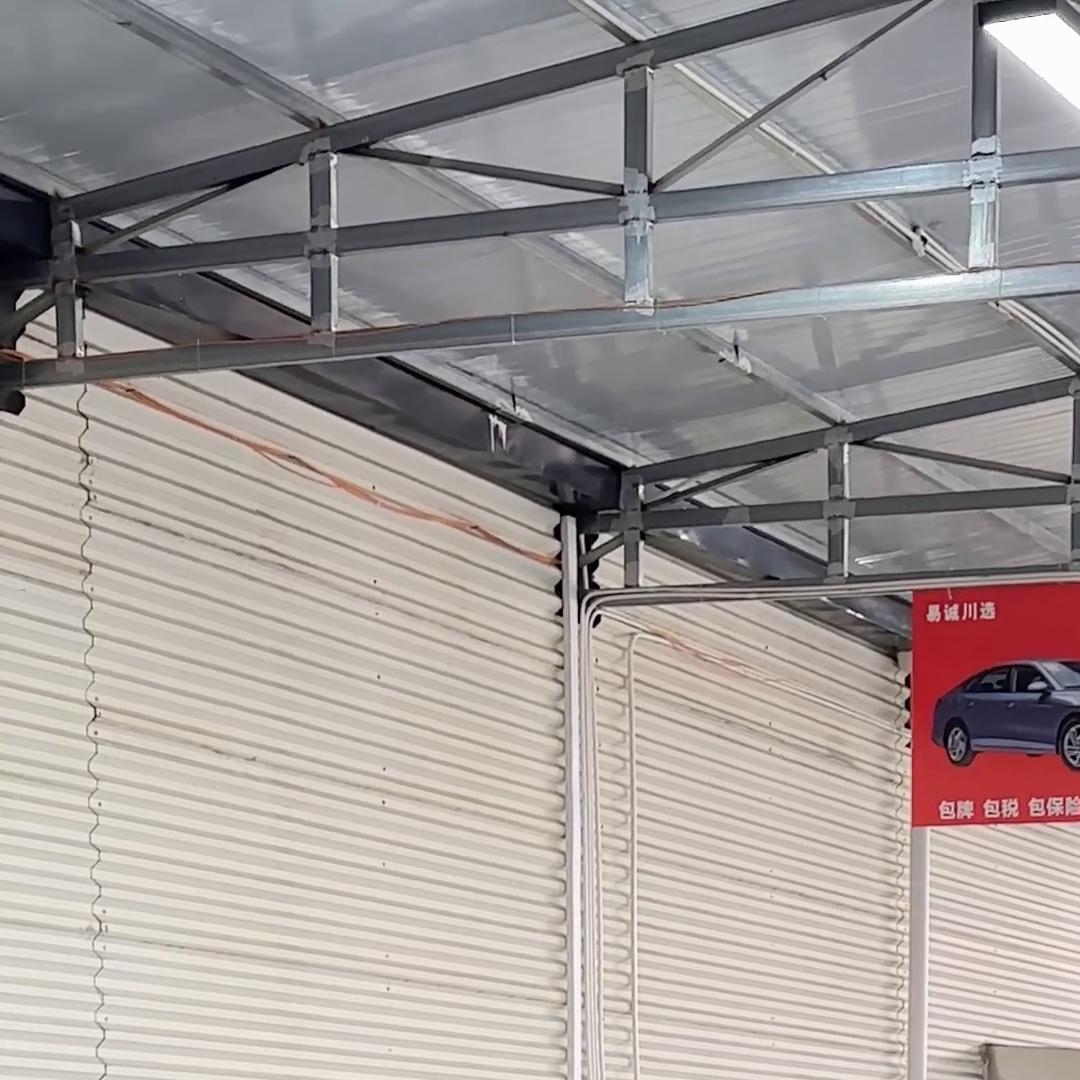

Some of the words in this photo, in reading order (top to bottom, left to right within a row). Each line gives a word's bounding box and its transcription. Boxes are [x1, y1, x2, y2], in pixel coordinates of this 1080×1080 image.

[926, 602, 997, 622] 易诚川选
[938, 799, 975, 821] 包牌
[983, 797, 1020, 819] 包税
